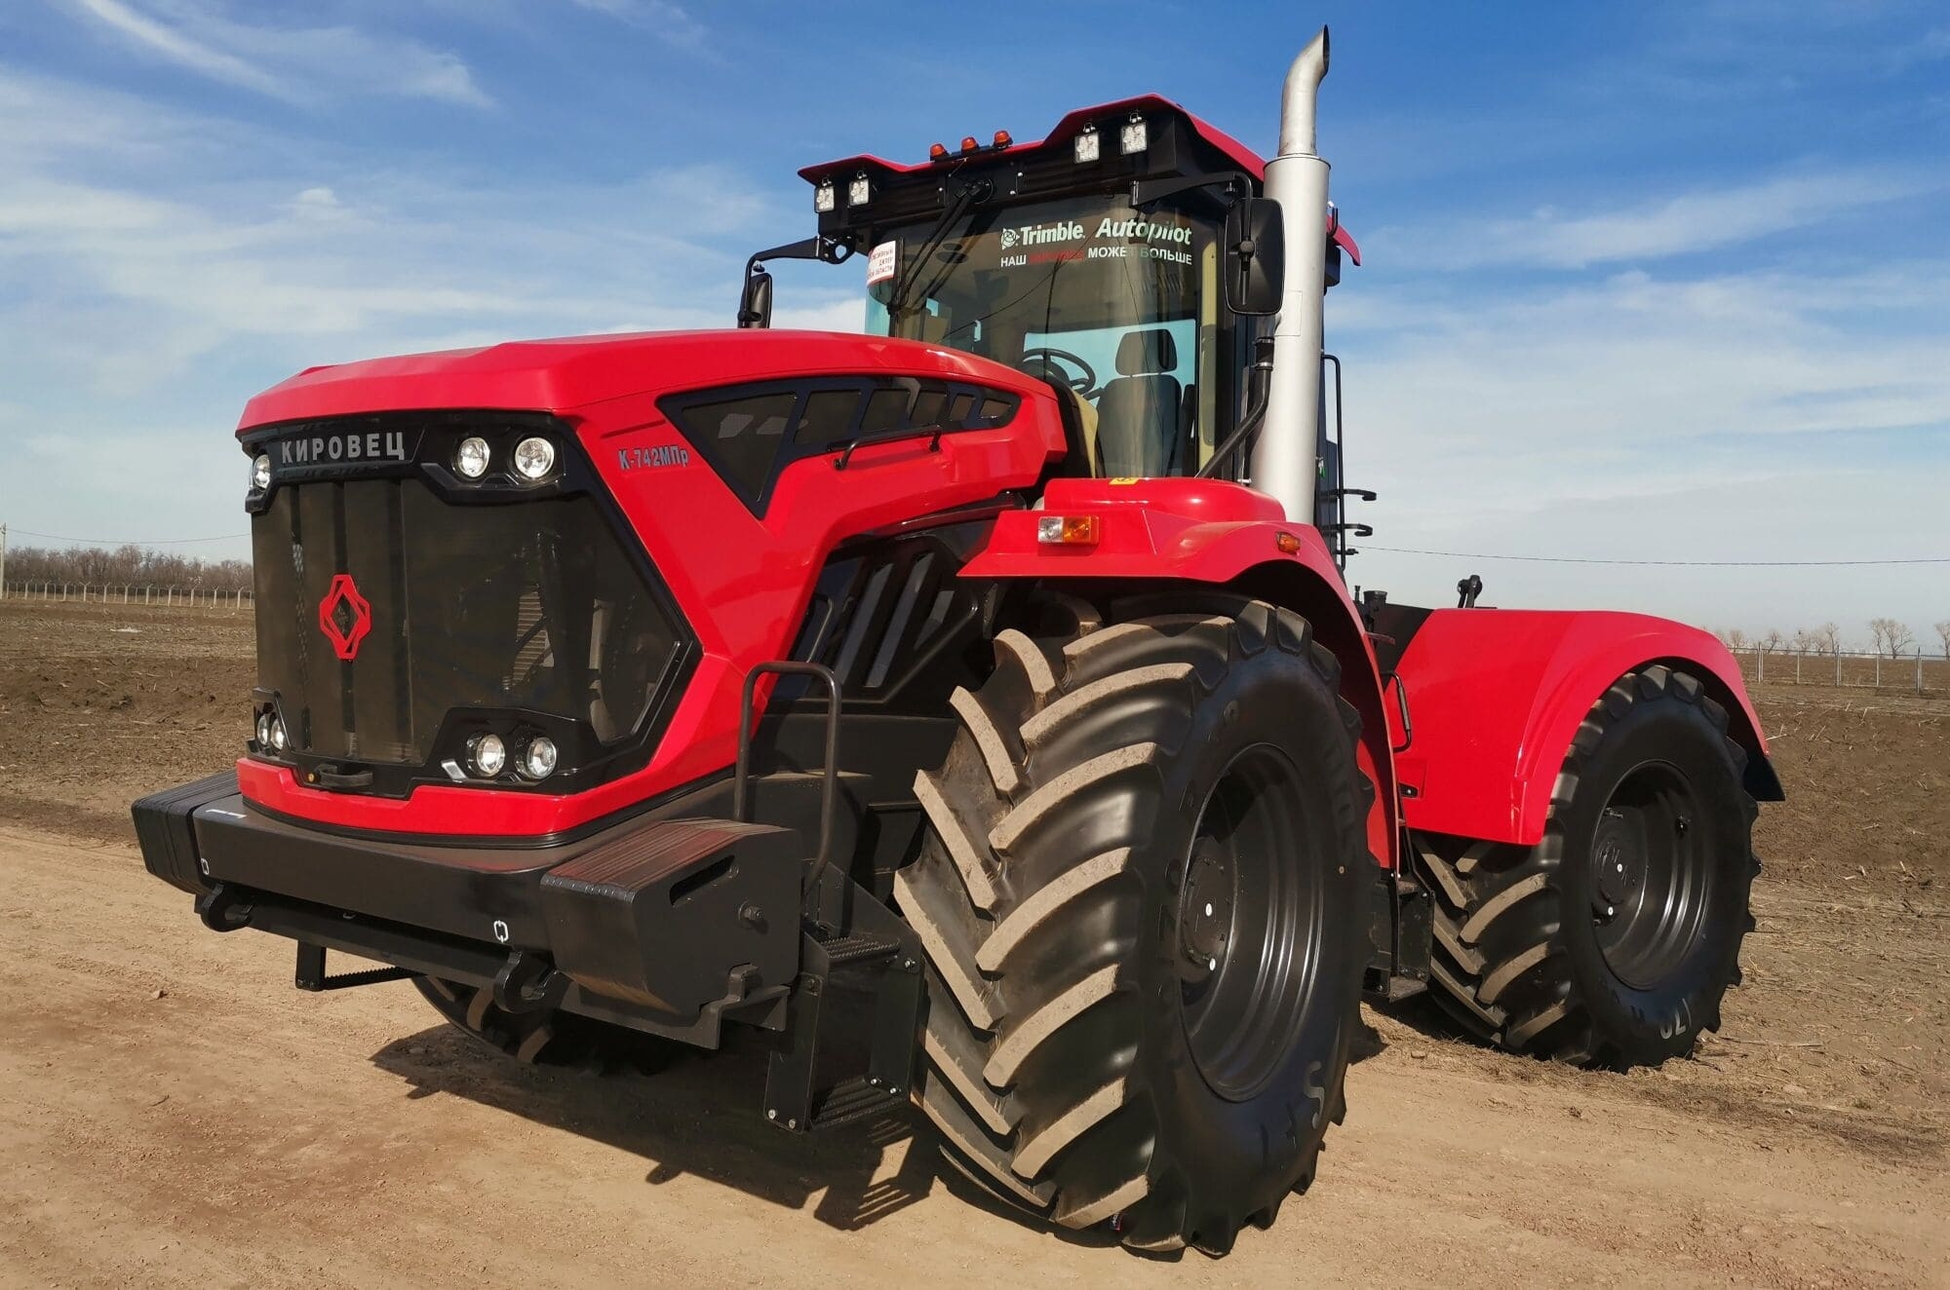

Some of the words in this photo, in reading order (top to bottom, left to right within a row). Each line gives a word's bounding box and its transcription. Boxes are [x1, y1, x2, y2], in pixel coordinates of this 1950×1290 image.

[1020, 221, 1084, 246] Trimble
[1095, 217, 1192, 245] Autopilot
[1000, 253, 1027, 267] НАШ
[1140, 247, 1193, 265] БОЛЬШЕ
[281, 431, 405, 464] КИРОВЕЦ
